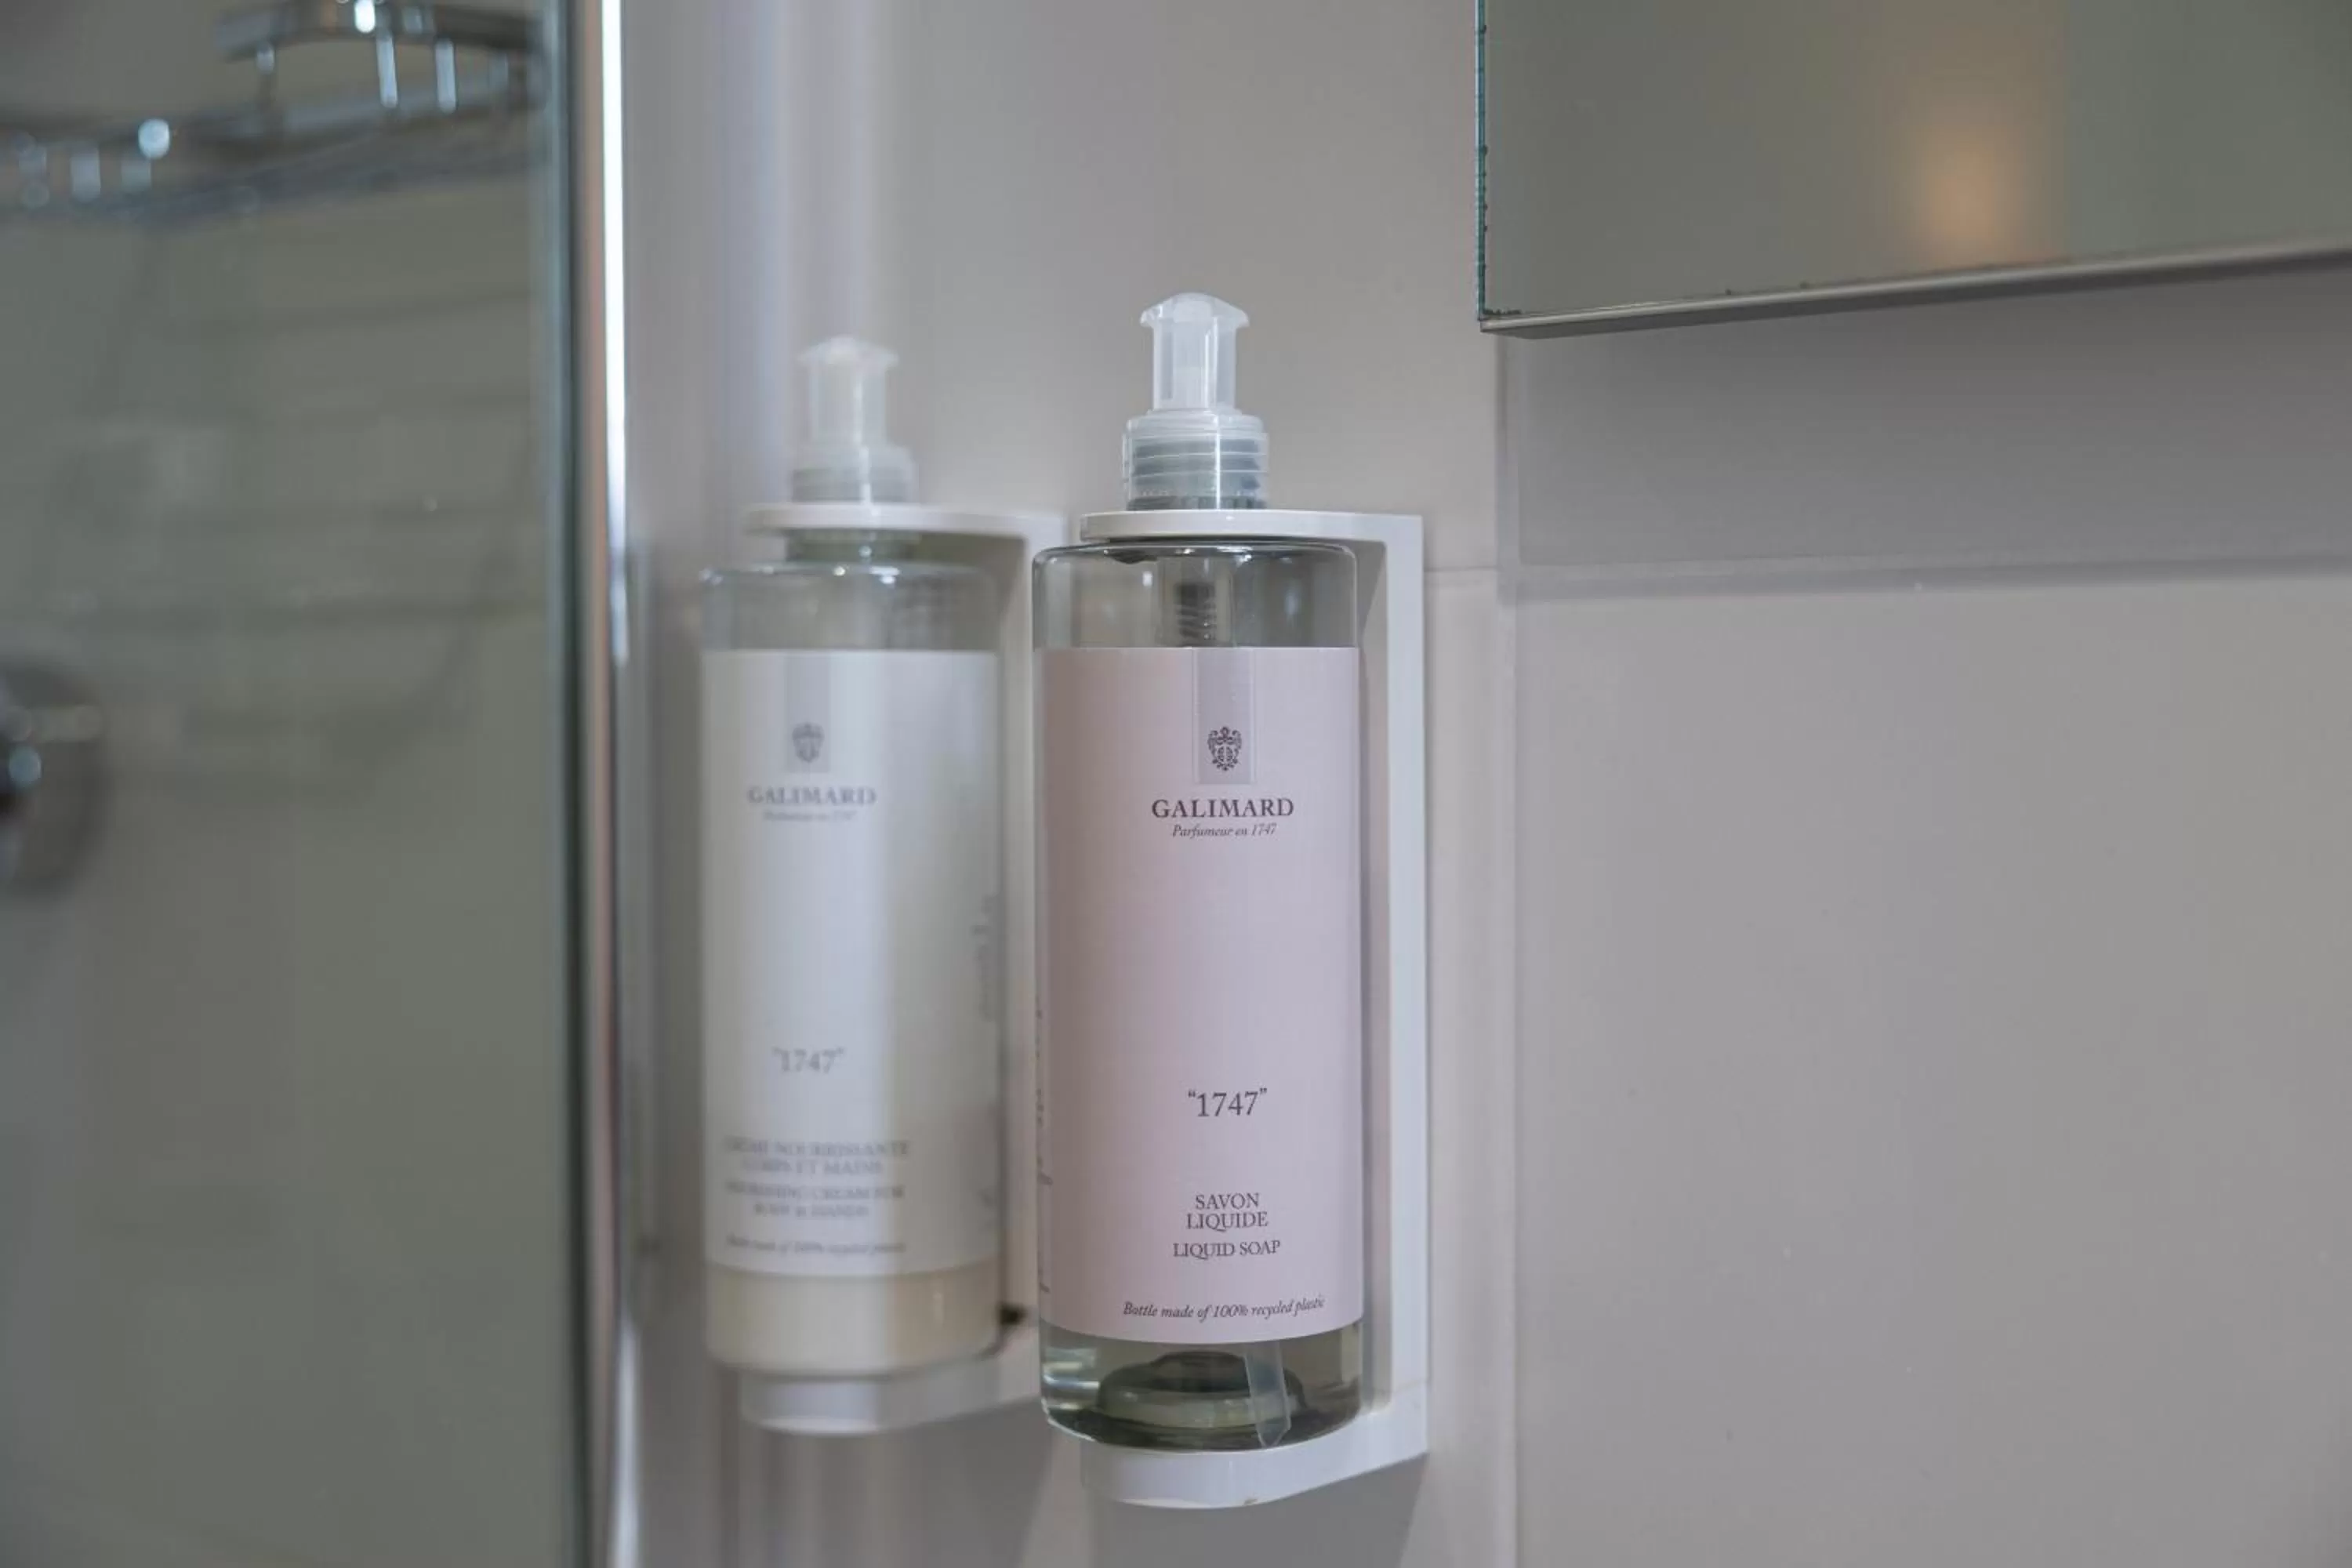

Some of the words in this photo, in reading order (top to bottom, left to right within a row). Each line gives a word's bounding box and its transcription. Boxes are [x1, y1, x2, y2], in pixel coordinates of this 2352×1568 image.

[748, 786, 877, 805] GALIMARD
[1151, 798, 1294, 818] GALIMARD
[1171, 824, 1234, 840] Parfumeur
[1235, 827, 1247, 837] en
[1251, 822, 1278, 837] 1747
[1188, 1087, 1268, 1118] “1747”
[1195, 1192, 1260, 1210] SAVON
[1186, 1211, 1269, 1232] LIQUIDE
[1173, 1242, 1236, 1260] LIQUID
[1240, 1240, 1281, 1256] SOAP
[1123, 1301, 1158, 1316] Bottle
[1161, 1304, 1194, 1318] made
[1196, 1304, 1213, 1323] of
[1213, 1304, 1249, 1318] 100%
[1250, 1299, 1295, 1320] recycled
[1291, 1294, 1326, 1317] plastic
